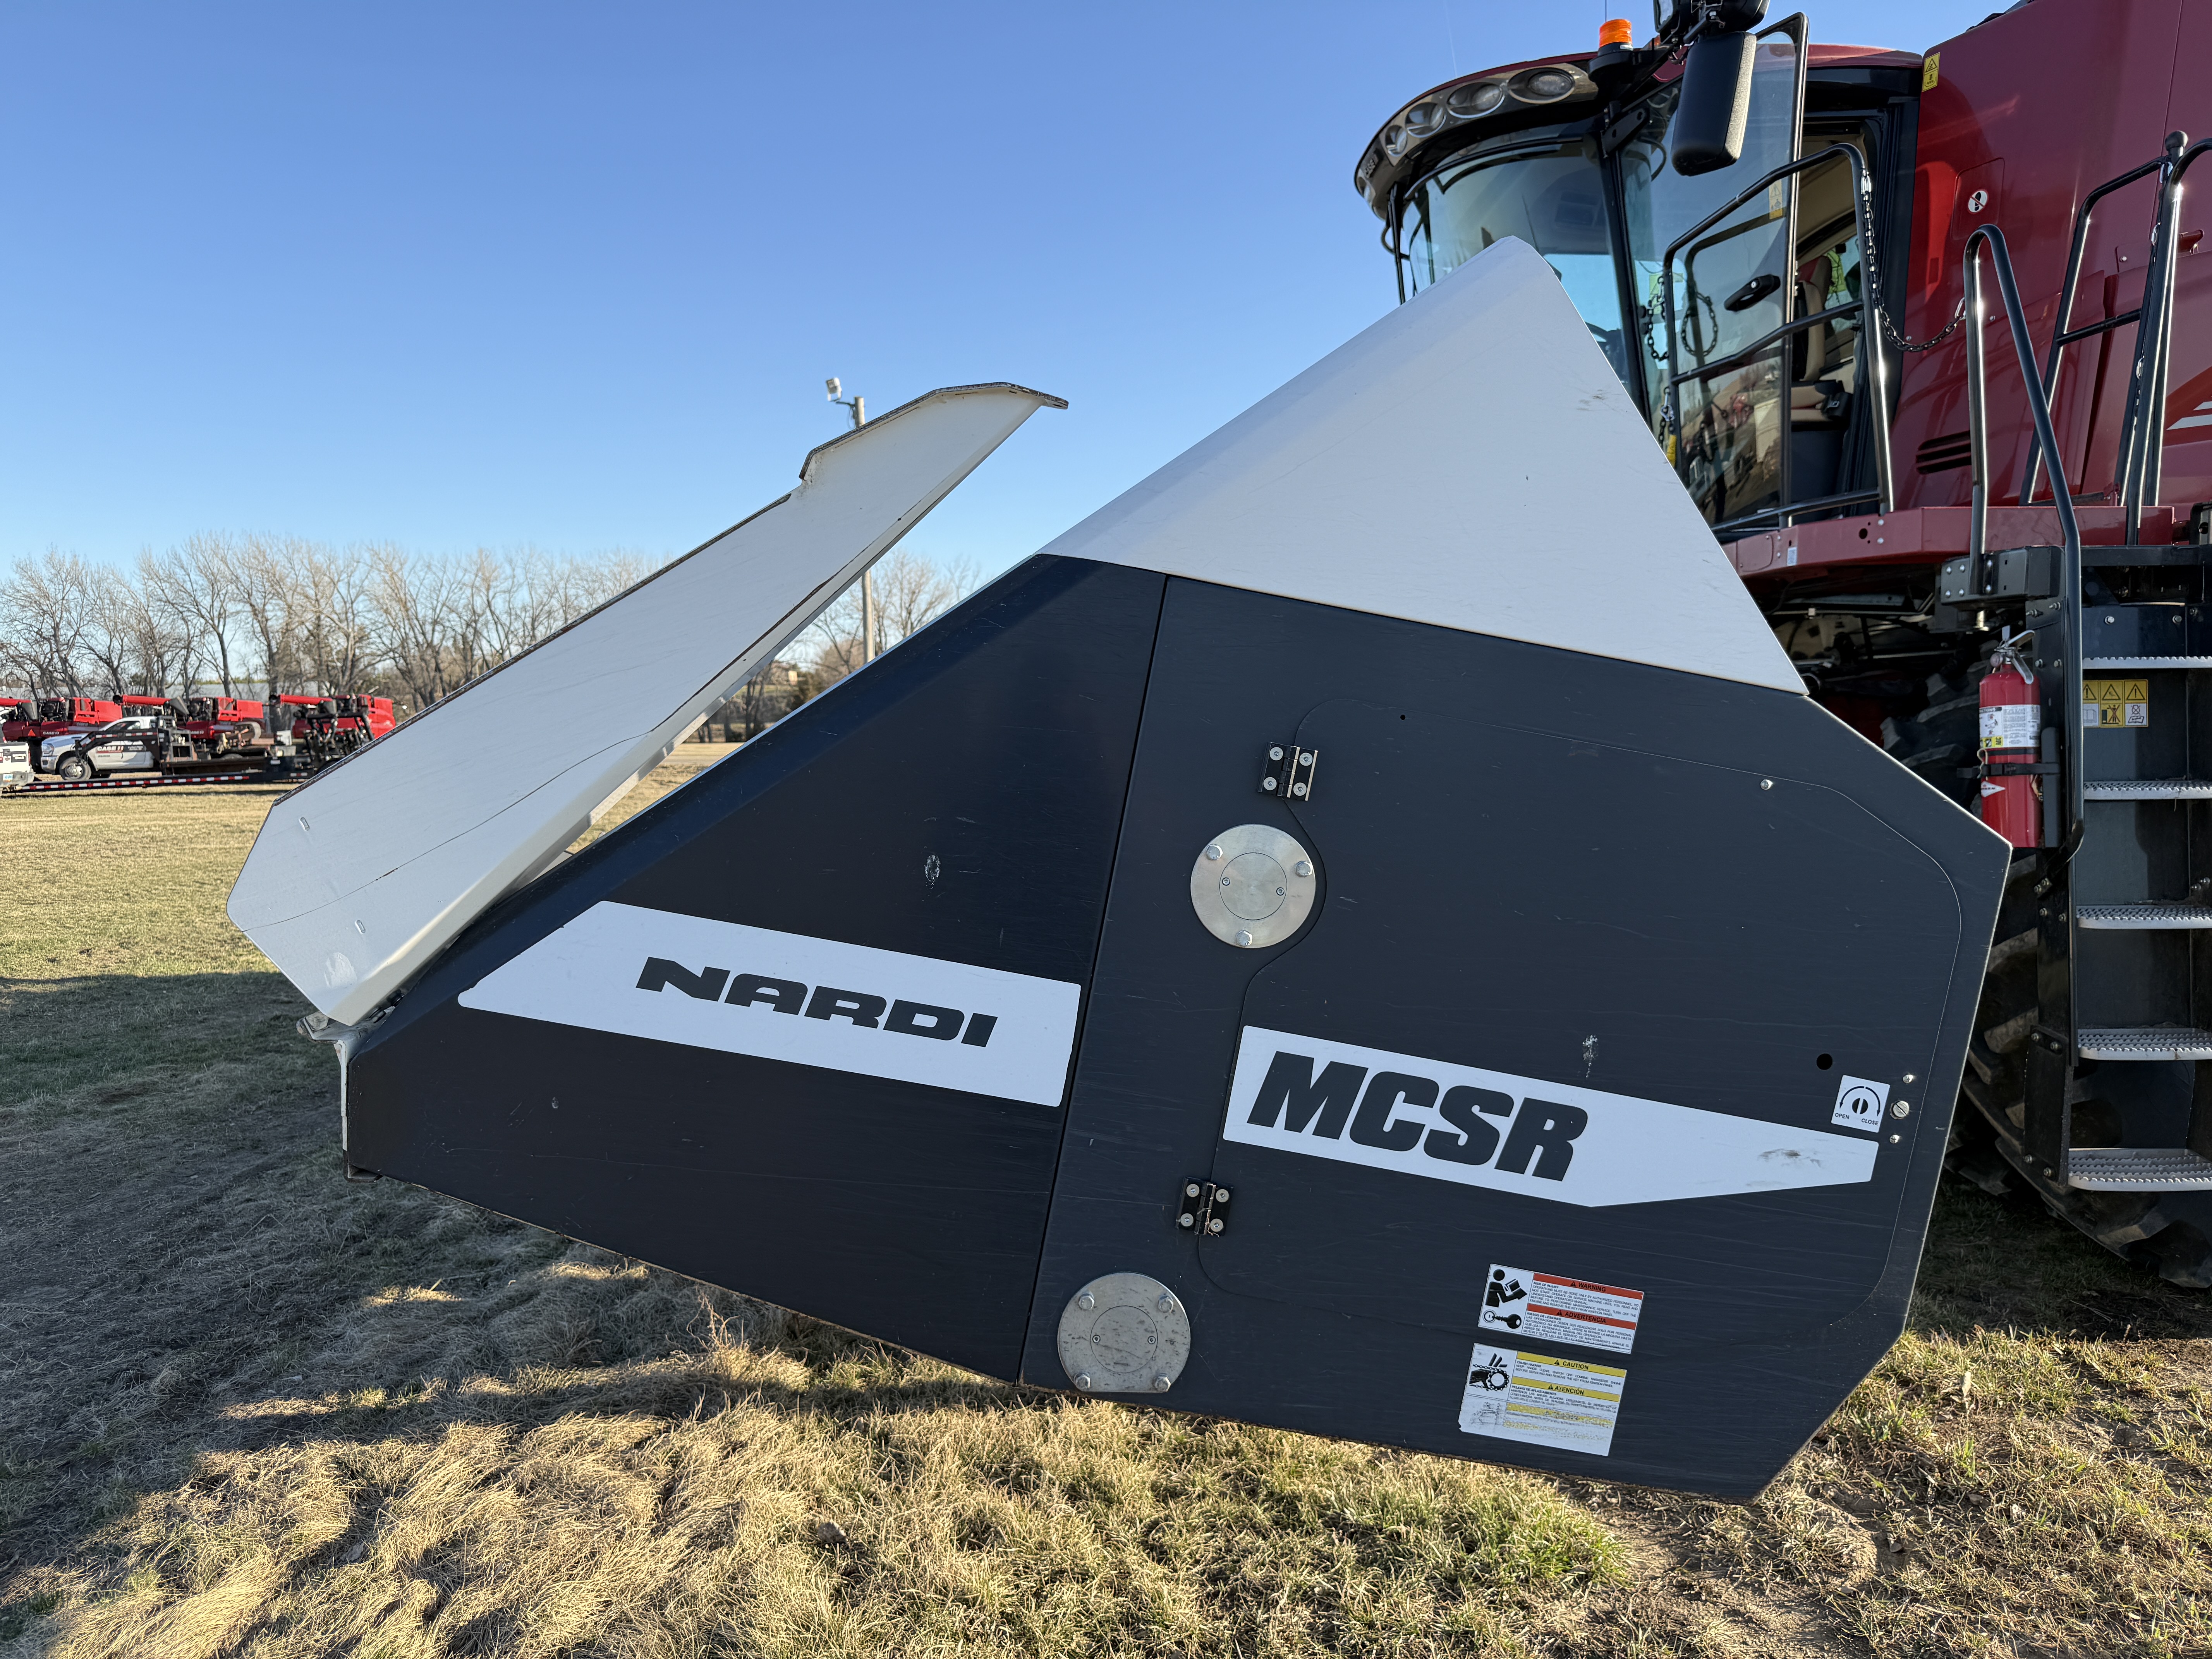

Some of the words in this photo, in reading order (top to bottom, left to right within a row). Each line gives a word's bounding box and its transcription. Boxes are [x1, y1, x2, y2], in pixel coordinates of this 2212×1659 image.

[636, 957, 998, 1047] NARDI
[1247, 1051, 1588, 1182] MCSR
[1578, 1282, 1606, 1292] WARNING
[1565, 1311, 1606, 1323] ADVERTENCIA
[1562, 1361, 1589, 1370] CAUTION
[1554, 1385, 1584, 1395] ATENCIÓN
